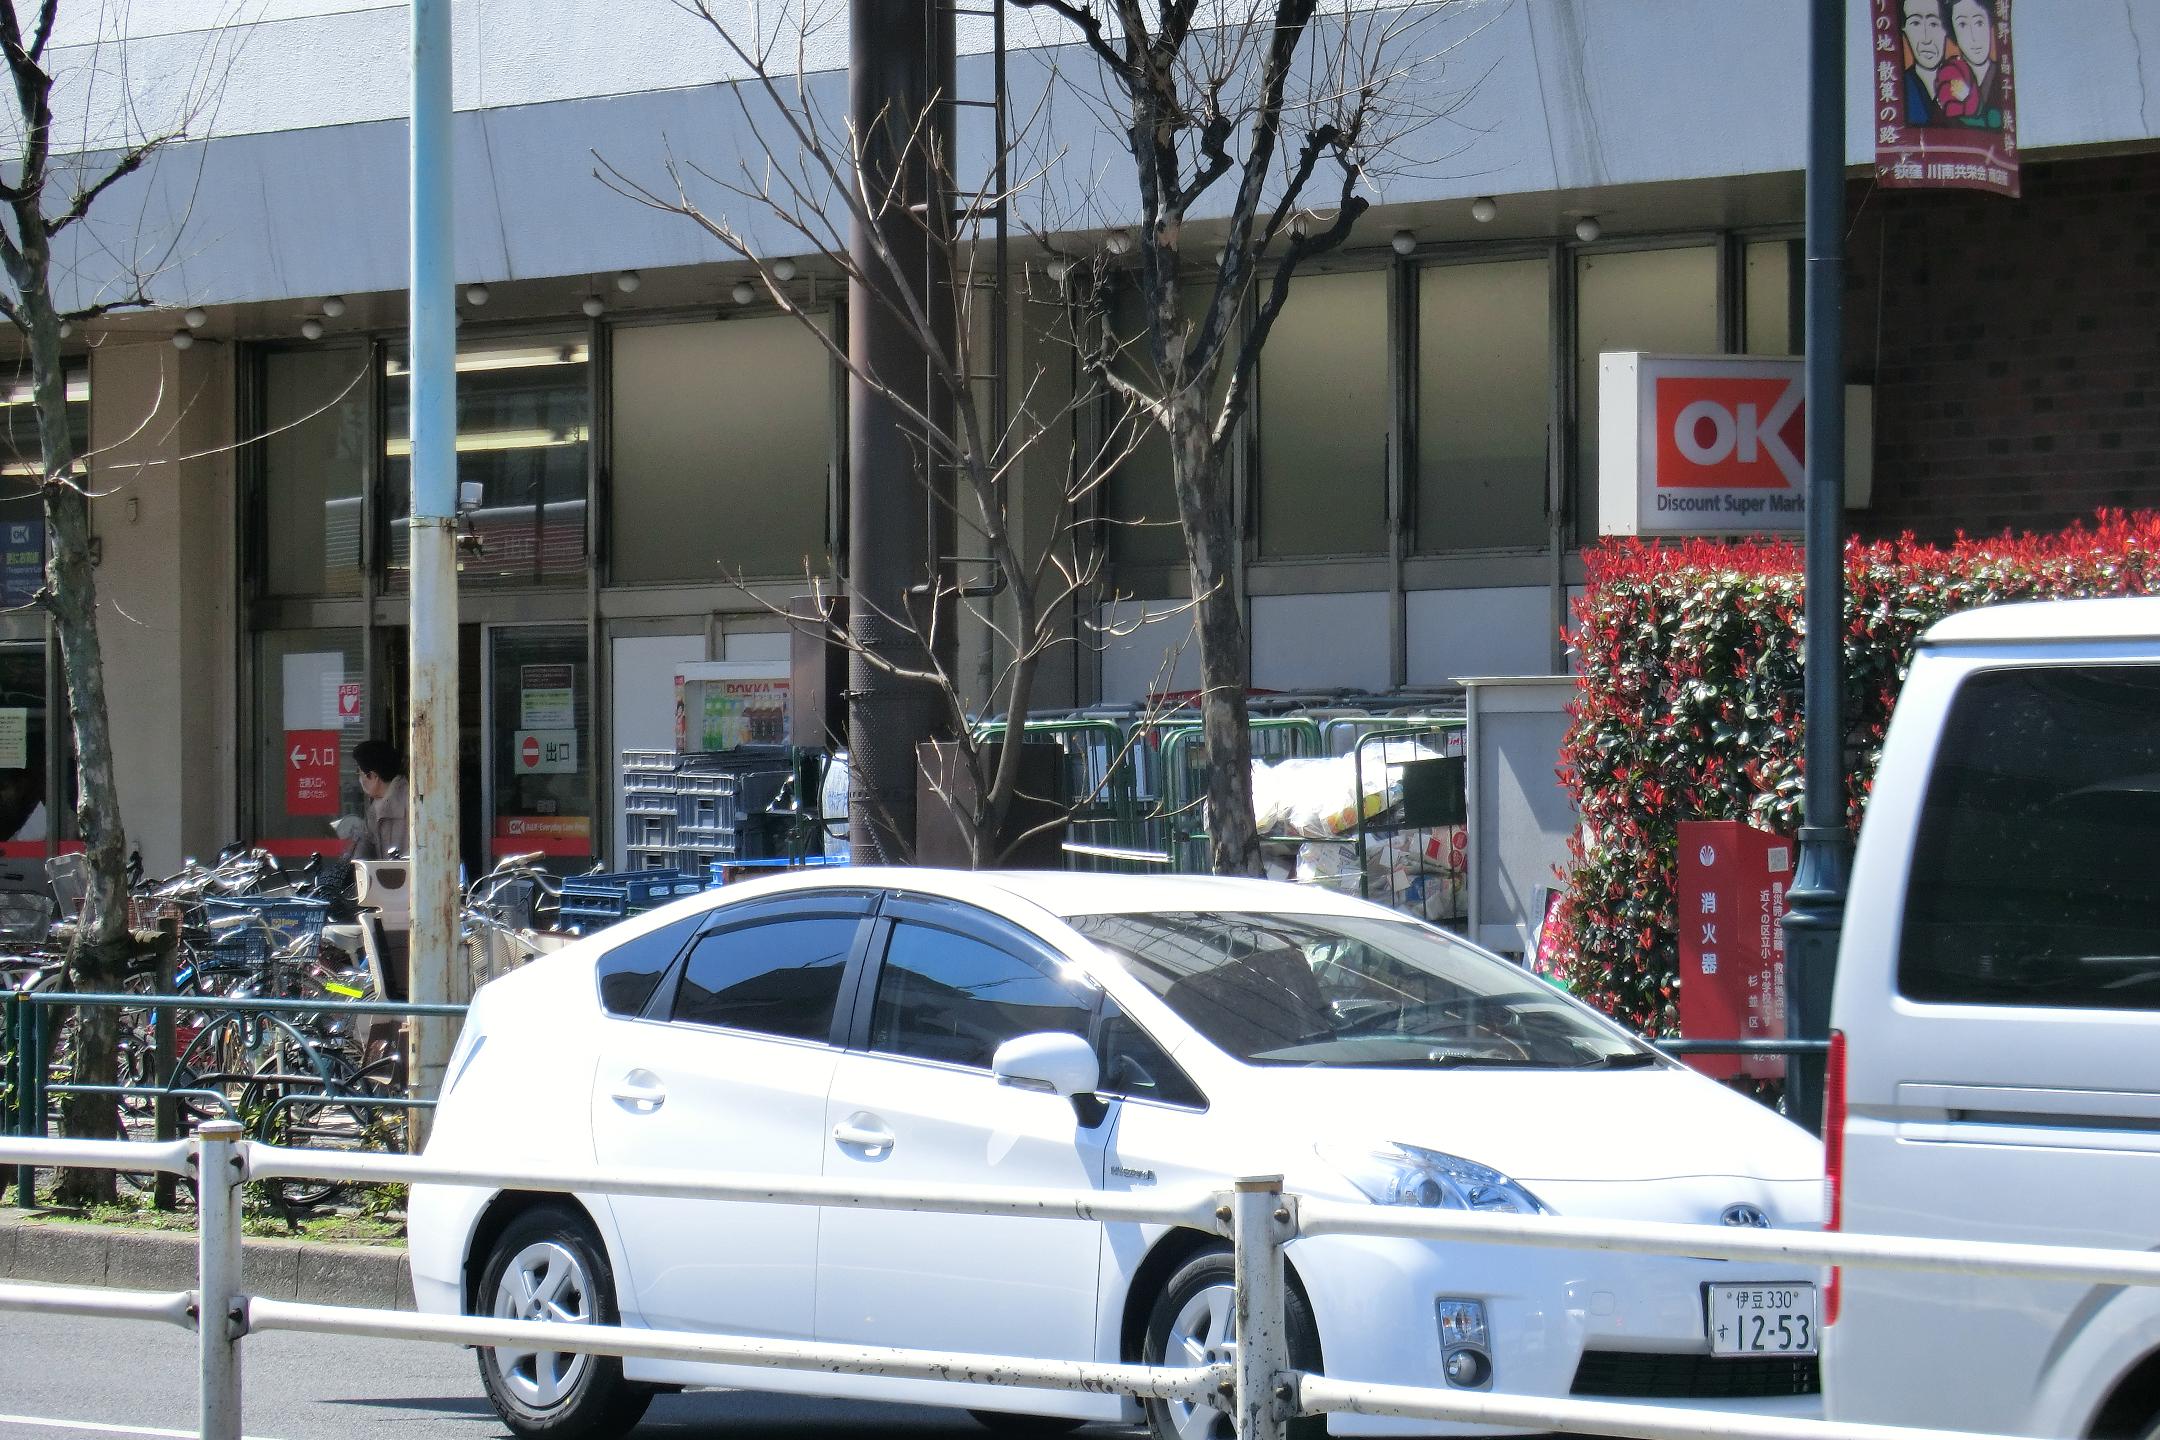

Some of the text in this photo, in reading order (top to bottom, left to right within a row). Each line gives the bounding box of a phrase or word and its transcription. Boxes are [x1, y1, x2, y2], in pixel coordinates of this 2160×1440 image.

[1674, 388, 1805, 480] OK
[1657, 493, 1805, 516] Discount Super Mark
[340, 685, 360, 695] AED
[310, 748, 335, 767] 入口
[546, 742, 570, 763] 出口
[1702, 893, 1718, 975] 消火器
[1748, 974, 1759, 1029] 杉並区
[1717, 1314, 1810, 1351] す 12-53
